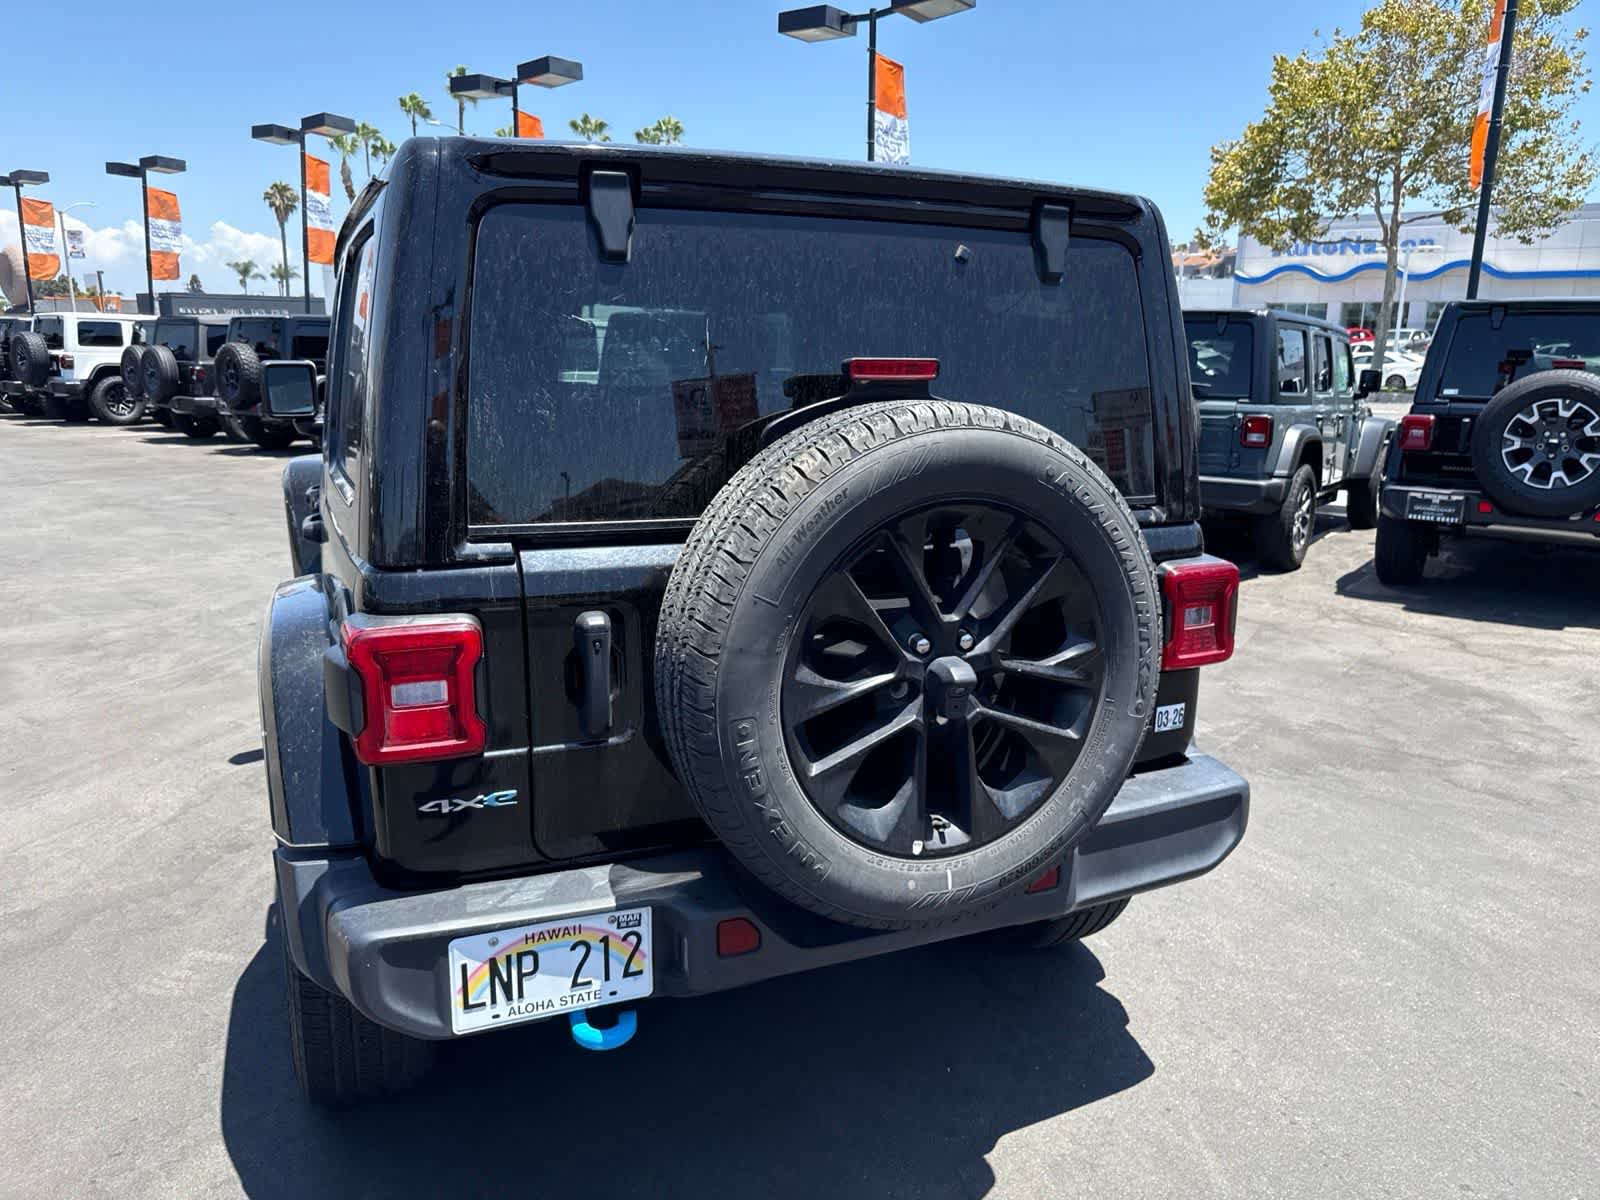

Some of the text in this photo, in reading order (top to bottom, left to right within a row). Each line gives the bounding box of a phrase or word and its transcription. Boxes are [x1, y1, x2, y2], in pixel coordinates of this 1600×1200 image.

[1272, 235, 1435, 256] utoNaon
[776, 488, 849, 567] All-Weather
[525, 924, 582, 944] HAWAII
[461, 930, 643, 1011] LNP 212
[508, 989, 601, 1017] ALOHA STATE
